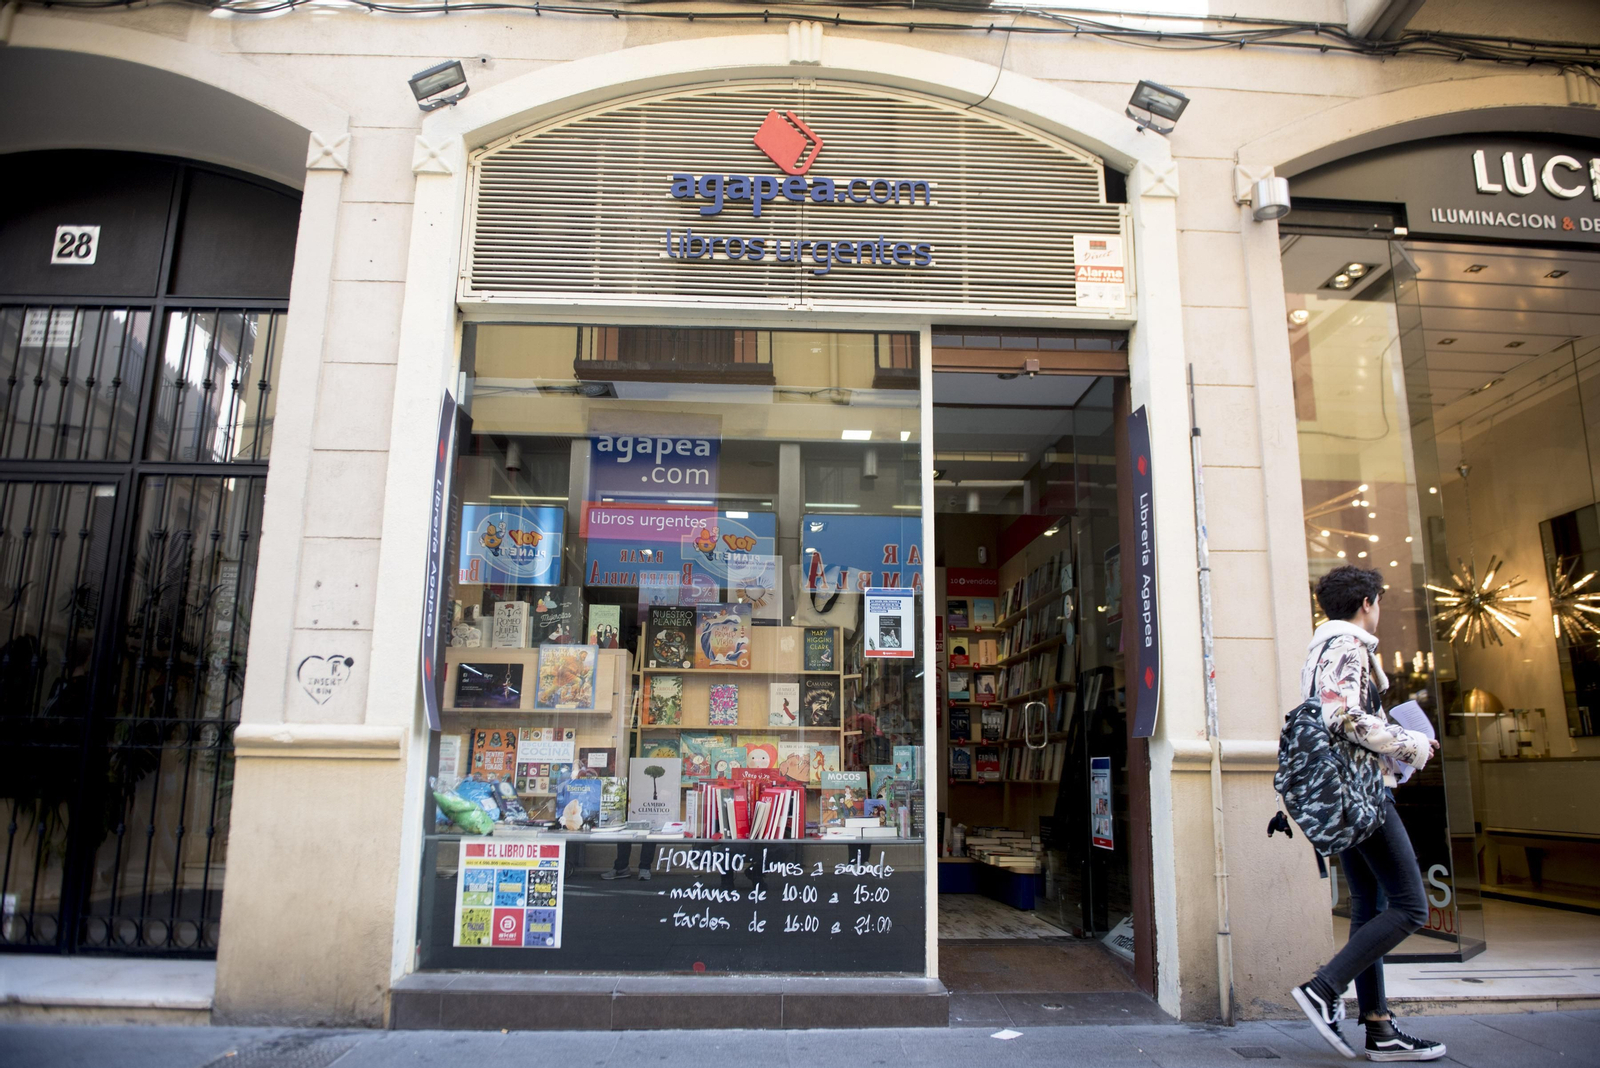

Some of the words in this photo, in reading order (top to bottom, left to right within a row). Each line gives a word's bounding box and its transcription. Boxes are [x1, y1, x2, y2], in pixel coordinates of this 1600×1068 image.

[1473, 149, 1600, 201] LUC
[670, 174, 931, 217] agapea.com
[1431, 207, 1556, 229] ILUMINACION
[1562, 216, 1575, 230] &
[56, 232, 92, 259] 28
[666, 228, 766, 260] libros
[776, 235, 933, 275] urgentes
[1077, 266, 1123, 278] Alarma
[597, 435, 711, 464] agapea
[591, 511, 635, 525] libros
[640, 515, 708, 531] urgentes
[1139, 492, 1150, 566] Librería
[966, 577, 997, 586] vendidos
[425, 560, 438, 639] Agapea
[652, 610, 694, 619] NUESTRO
[1141, 574, 1153, 648] Agapea
[496, 617, 521, 628] ROMEO
[653, 618, 692, 626] PLANETA
[308, 678, 343, 686] INSERT
[520, 747, 571, 756] COCINA
[827, 772, 861, 782] MOCOS
[566, 784, 591, 792] Esencia
[487, 844, 497, 857] EL
[499, 844, 524, 858] LIBRO
[526, 845, 538, 858] DE
[670, 881, 740, 903] mañanas
[748, 882, 767, 904] de
[782, 883, 818, 903] 10:00
[853, 884, 890, 904] 15:00
[673, 905, 731, 931] tardes
[748, 910, 767, 933] de
[783, 914, 820, 933] 16:00
[854, 914, 893, 936] 21:00
